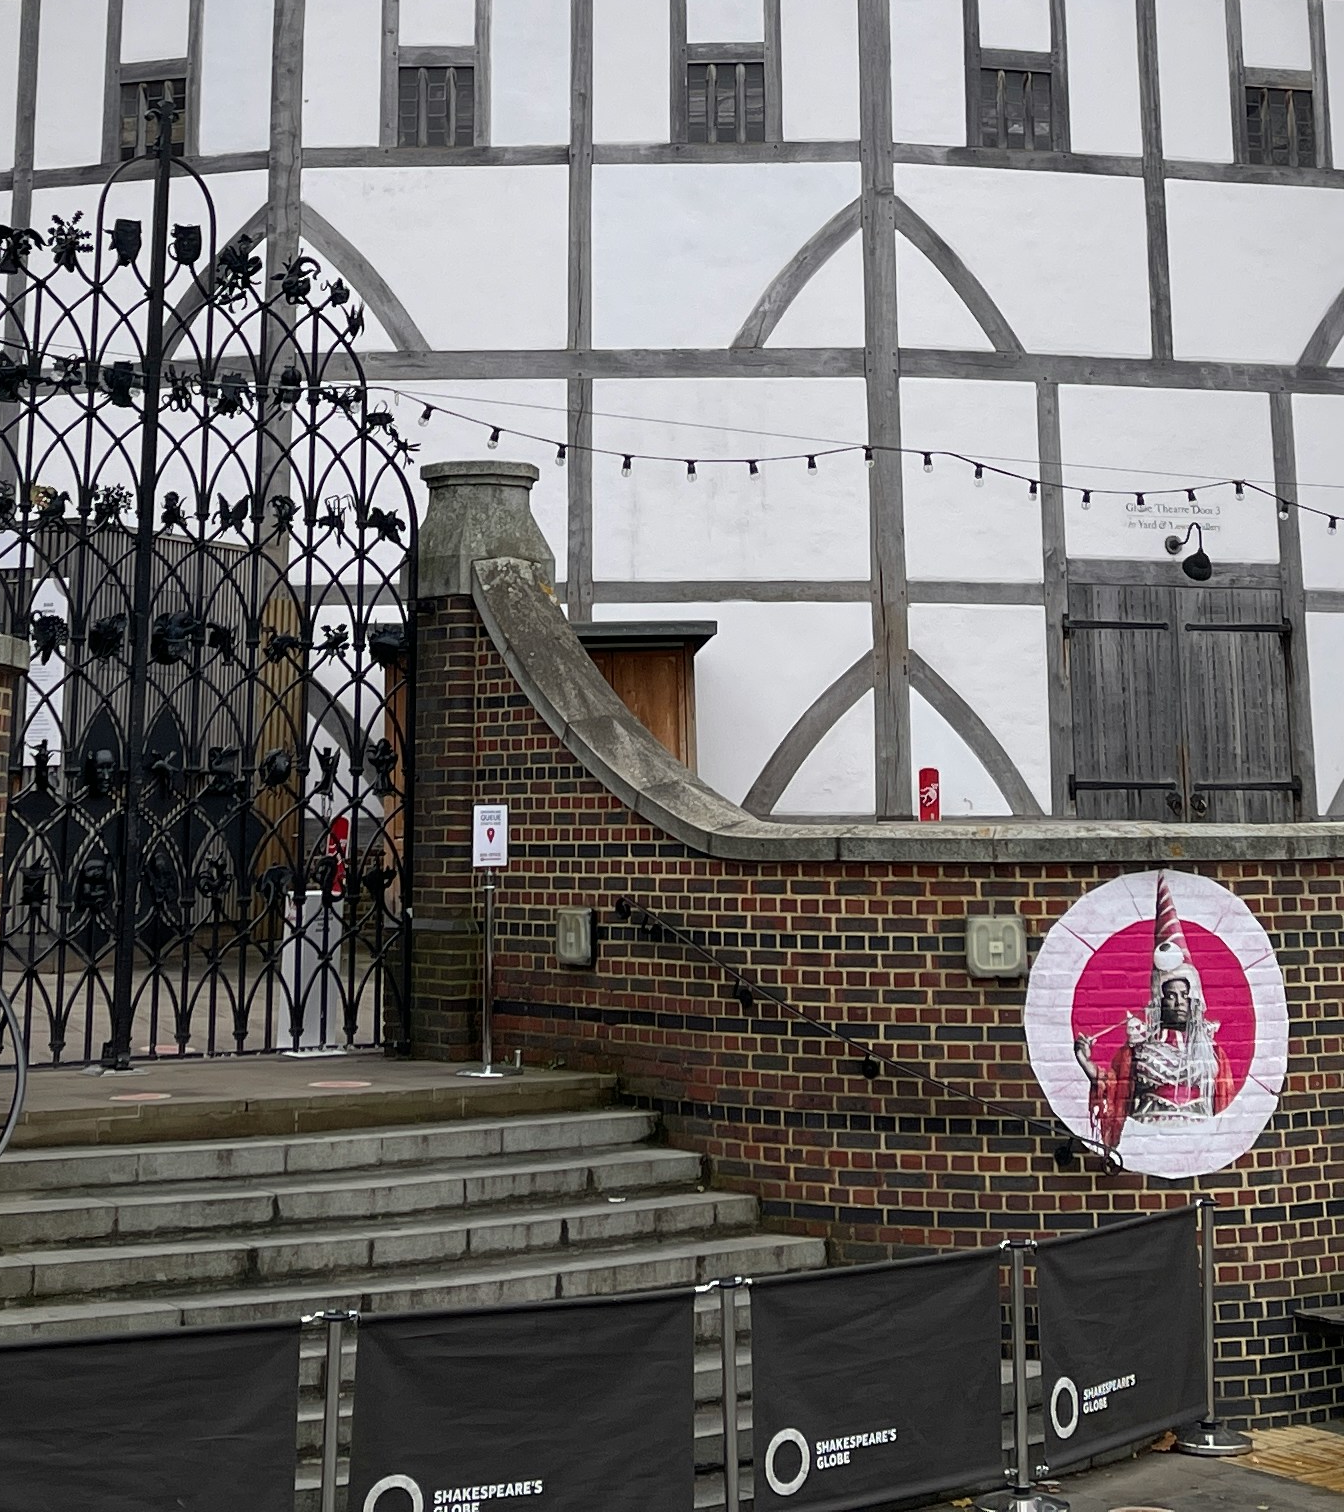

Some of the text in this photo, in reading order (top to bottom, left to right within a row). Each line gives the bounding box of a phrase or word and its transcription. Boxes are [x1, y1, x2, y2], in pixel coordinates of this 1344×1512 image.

[1126, 502, 1152, 513] Gle
[480, 814, 501, 822] QUEUE
[1083, 1374, 1136, 1401] SHAKESPEARE'S
[1083, 1397, 1108, 1415] GLOBE
[816, 1428, 897, 1455] SHAKESPEARE'S
[817, 1451, 851, 1470] GLOBE
[434, 1480, 544, 1505] SHAKESPEARE'S
